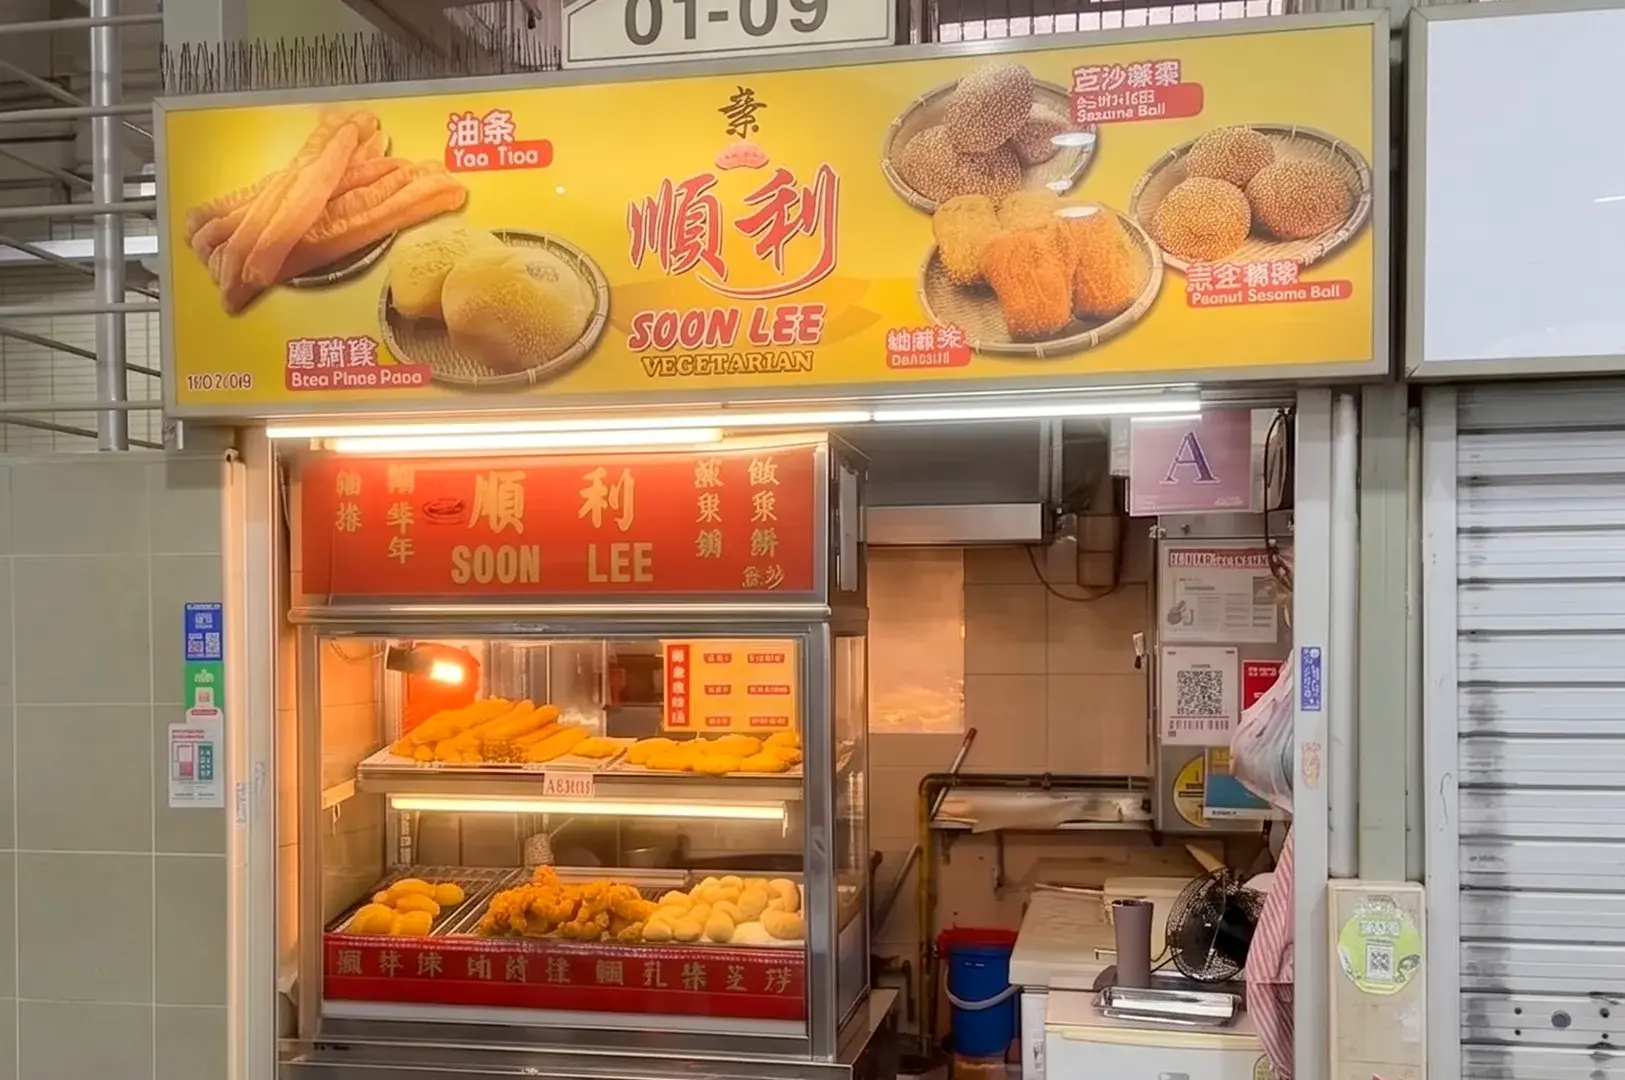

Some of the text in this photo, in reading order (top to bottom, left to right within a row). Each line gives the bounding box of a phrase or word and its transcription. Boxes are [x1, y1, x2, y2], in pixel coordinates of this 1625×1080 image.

[624, 0, 829, 46] 01-09
[627, 163, 839, 300] 順利
[1310, 285, 1340, 299] Ball
[627, 303, 825, 352] SOON LEE
[641, 349, 815, 377] VEGETARIAN
[1159, 430, 1222, 484] A
[451, 542, 655, 585] SOON LEE
